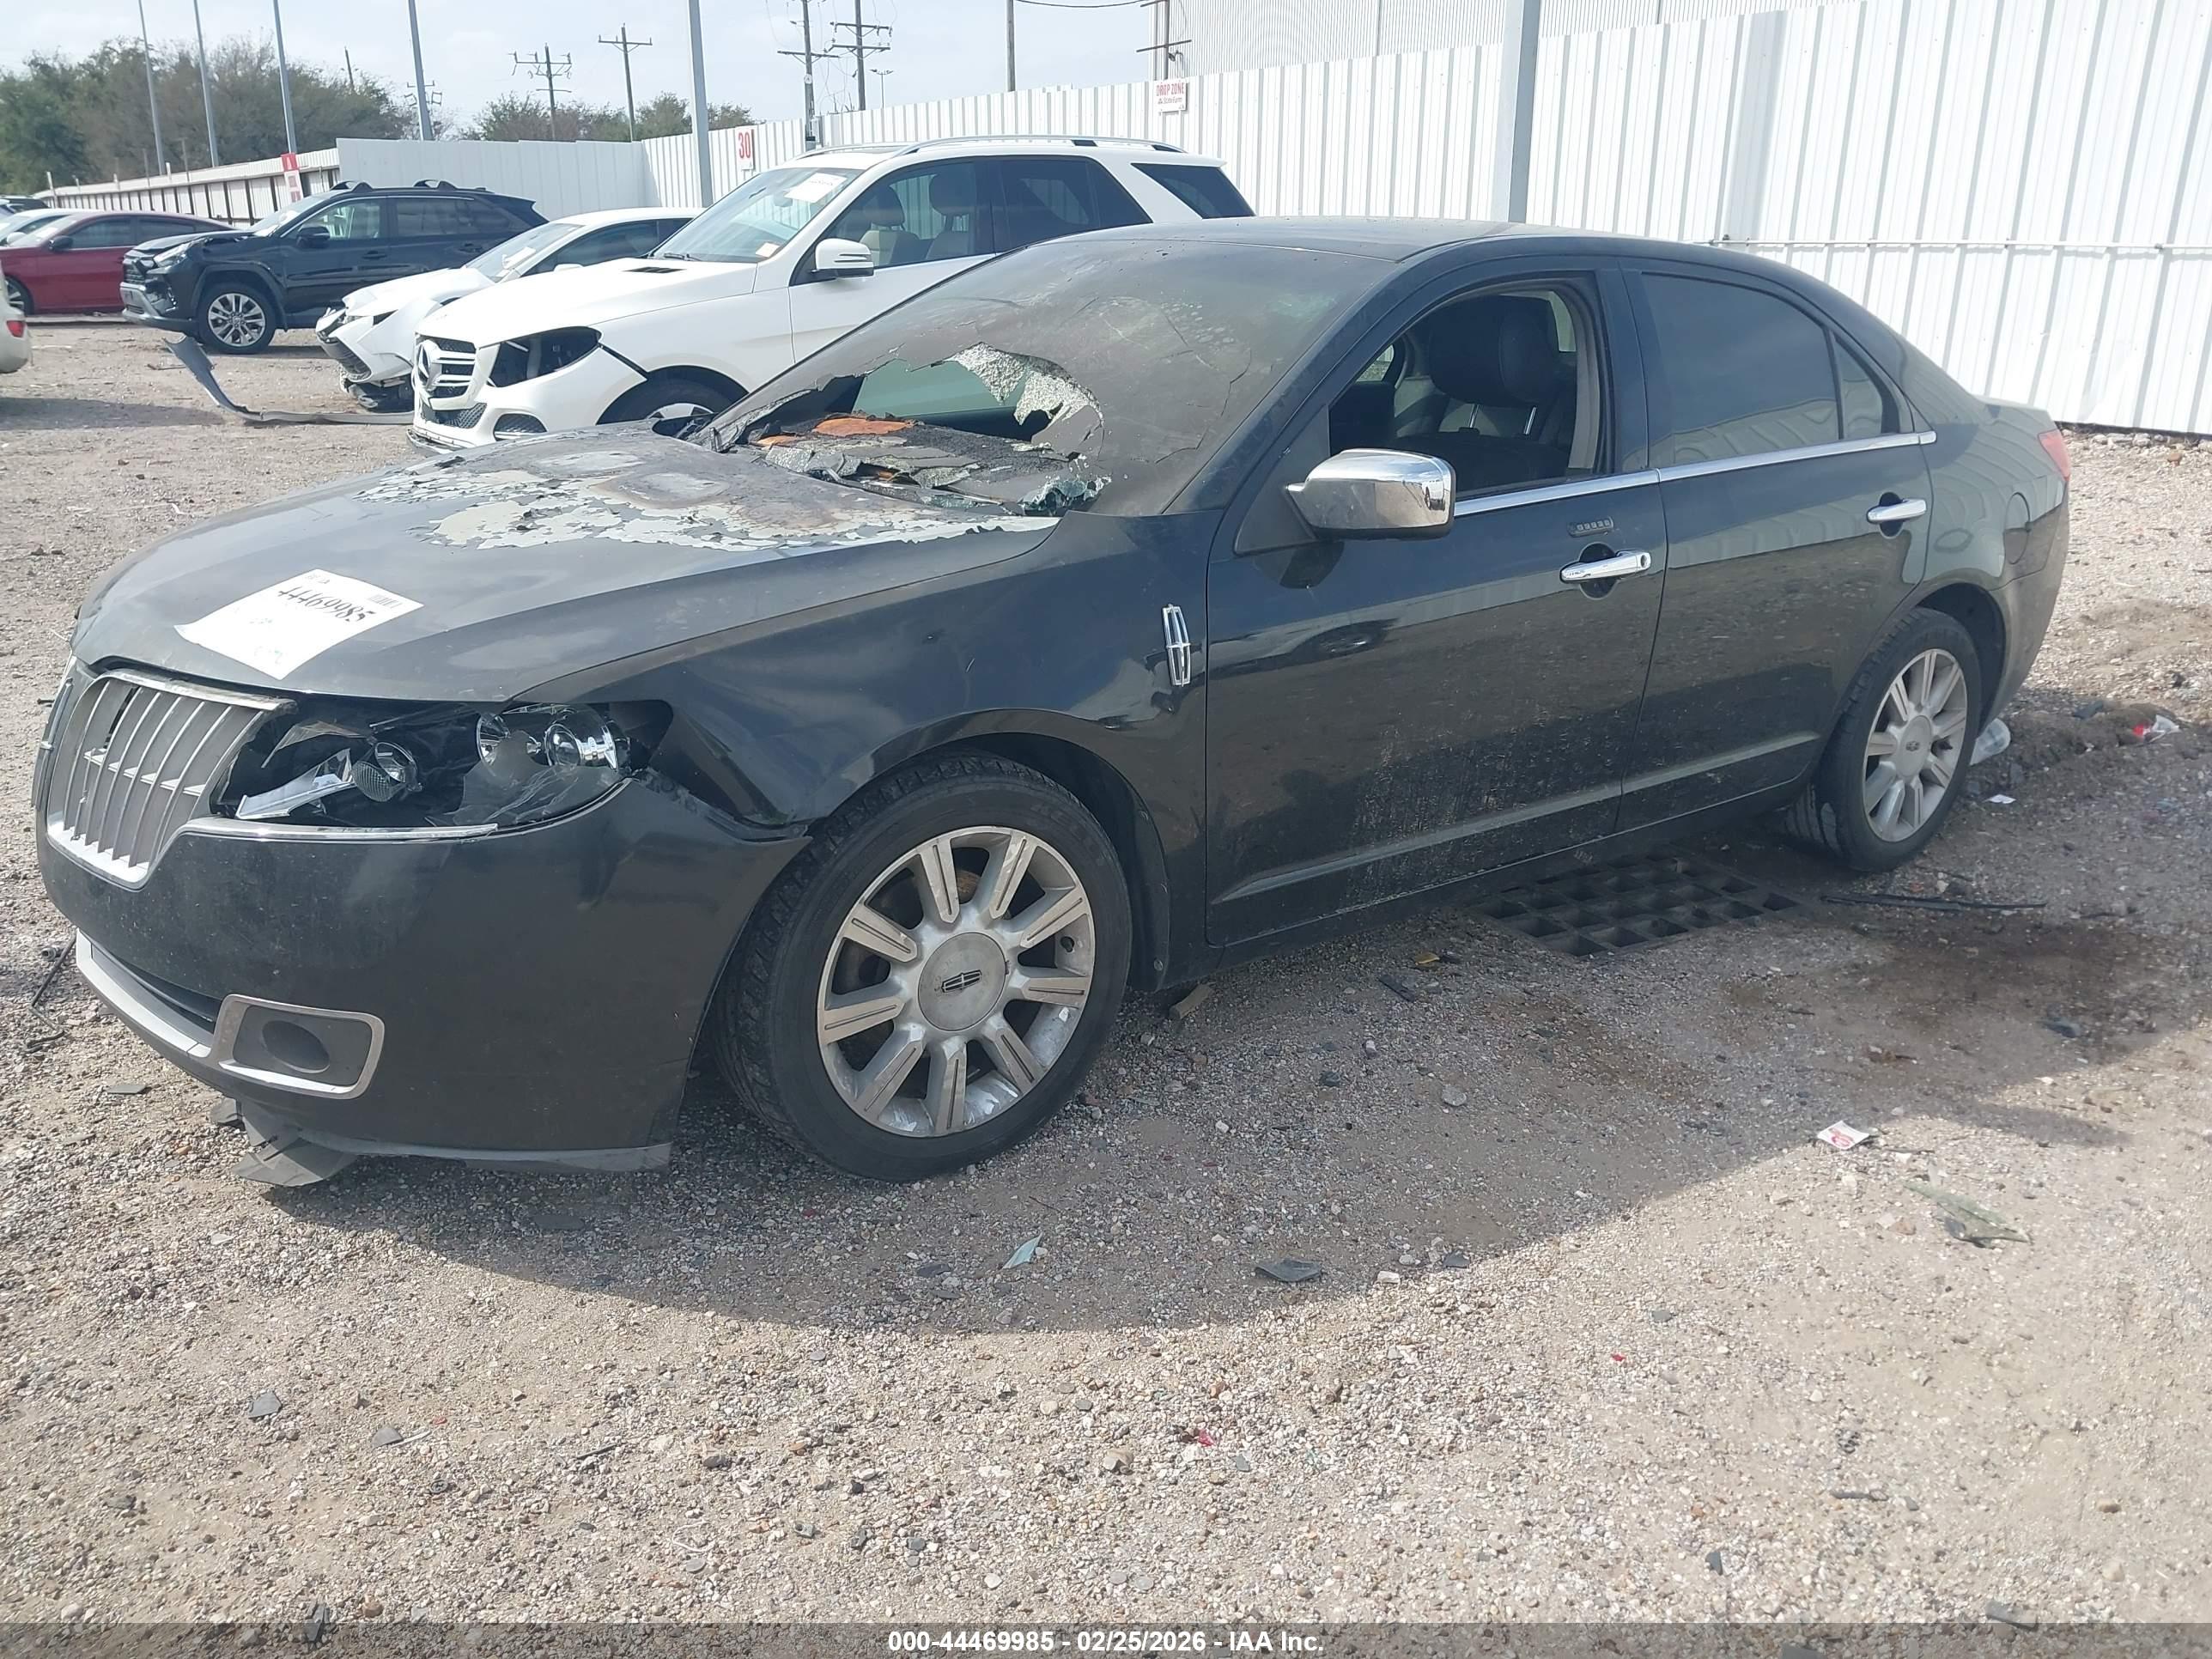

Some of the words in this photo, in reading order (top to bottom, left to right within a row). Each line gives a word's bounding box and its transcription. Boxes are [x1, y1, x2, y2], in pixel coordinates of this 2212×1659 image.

[1156, 83, 1170, 96] DROP
[1170, 82, 1184, 94] ZONE
[738, 131, 751, 159] 30
